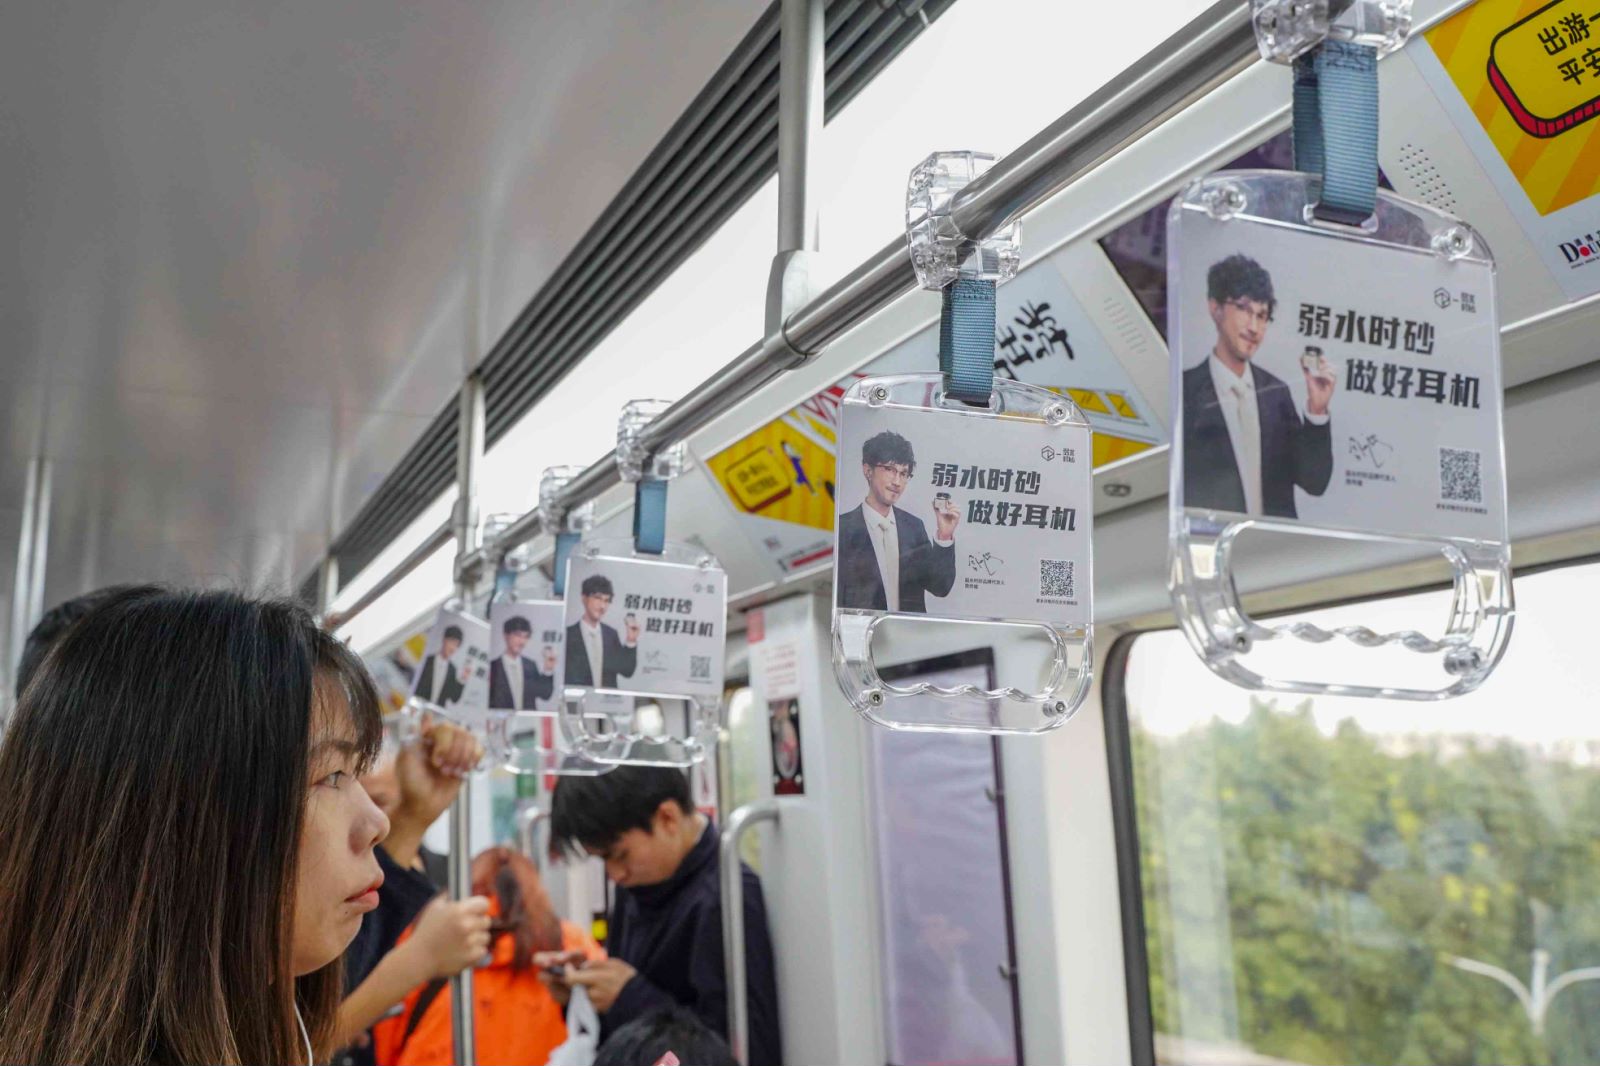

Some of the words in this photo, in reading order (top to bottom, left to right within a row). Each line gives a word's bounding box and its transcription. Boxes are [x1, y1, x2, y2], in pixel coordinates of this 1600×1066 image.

[1298, 303, 1435, 355] 弱水时砂
[1346, 358, 1480, 409] 做好耳机
[931, 463, 1041, 495] 弱水时砂
[967, 500, 1076, 531] 做好耳机
